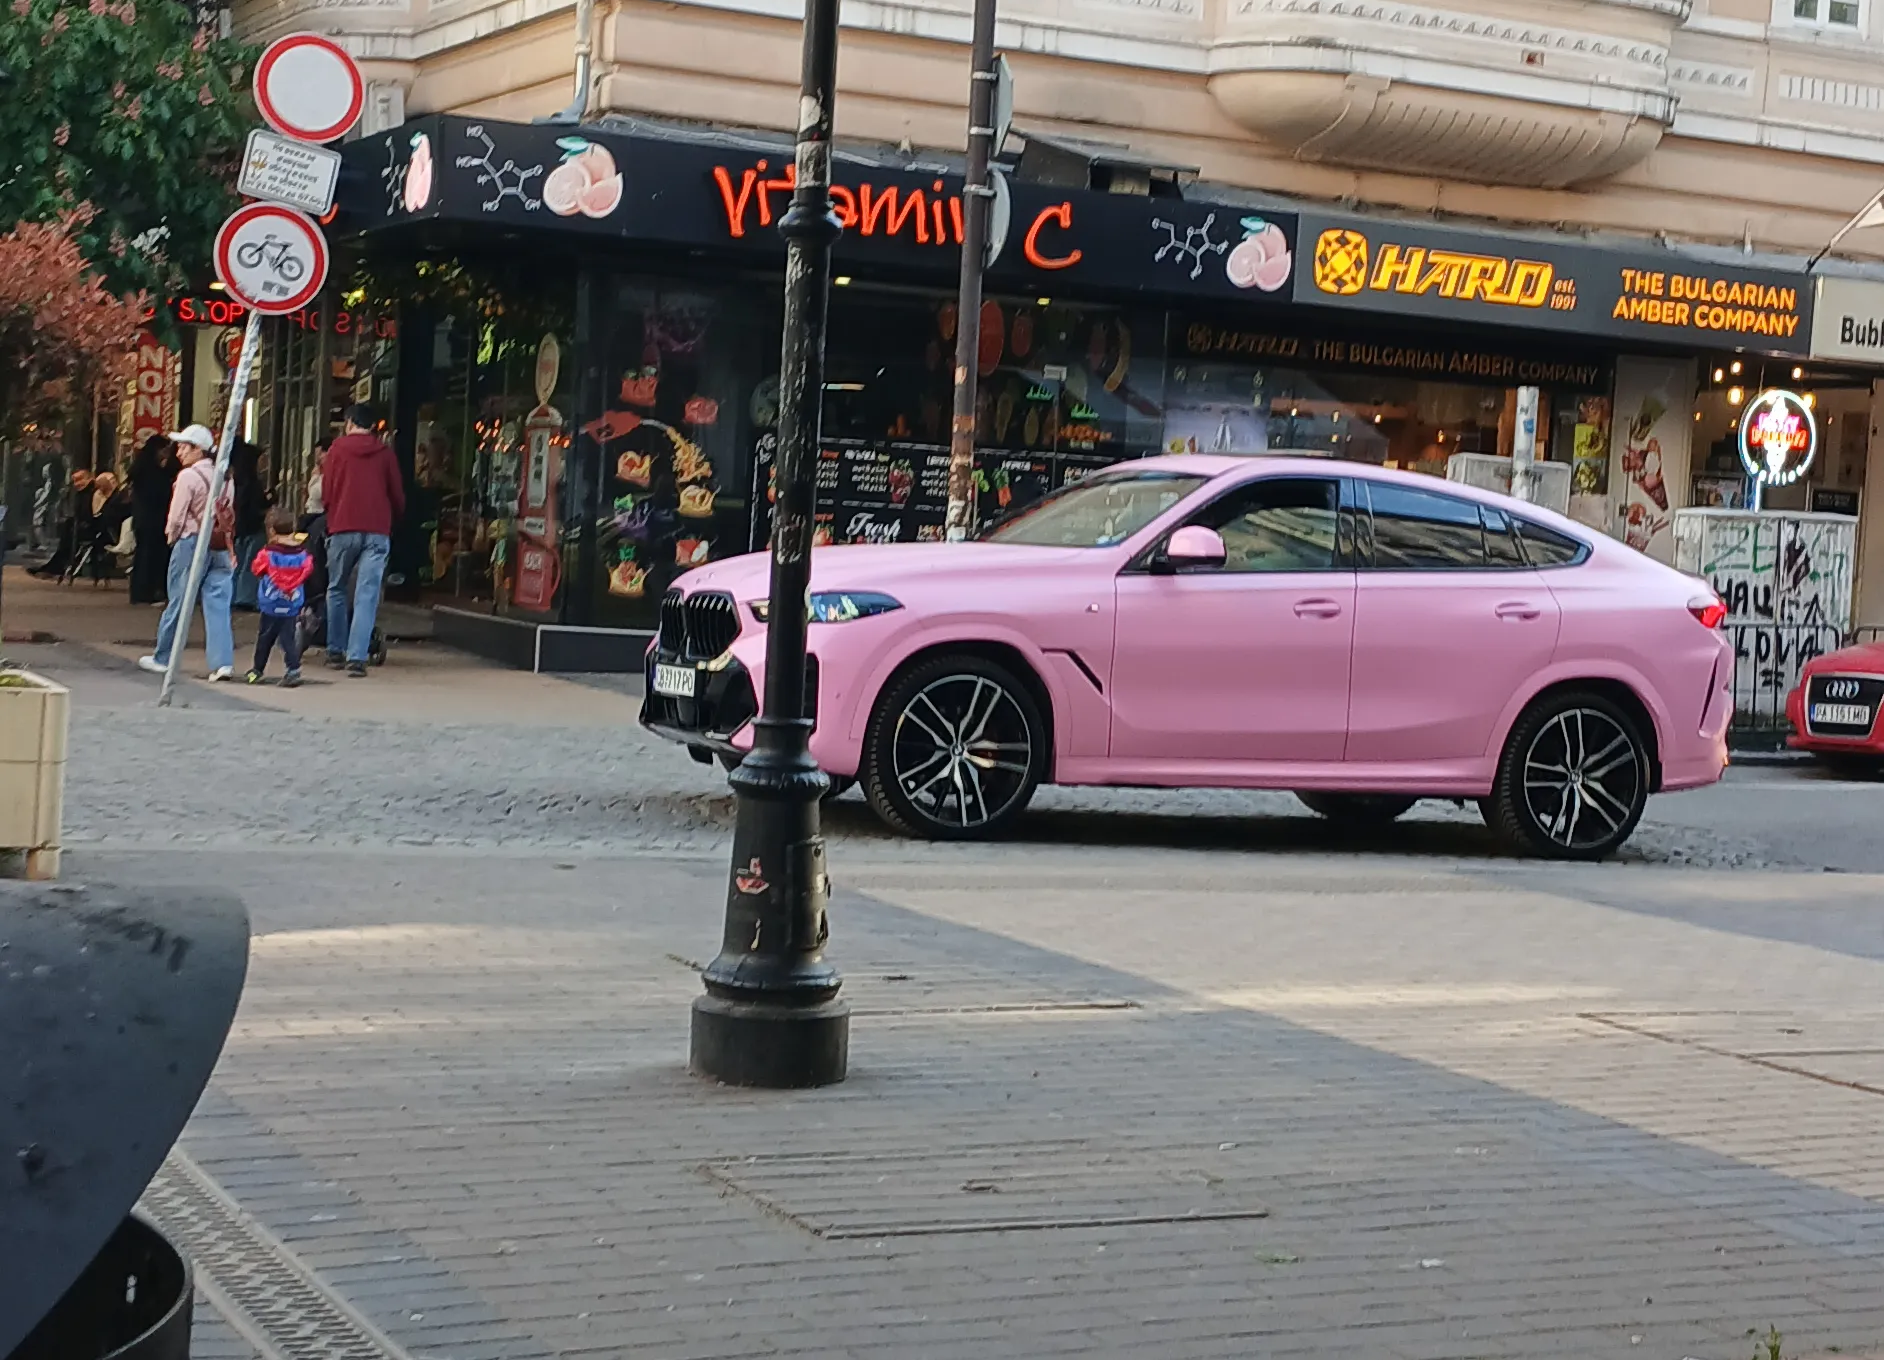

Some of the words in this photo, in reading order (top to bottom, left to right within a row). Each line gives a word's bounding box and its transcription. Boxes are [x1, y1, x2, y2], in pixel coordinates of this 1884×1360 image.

[1023, 201, 1083, 270] C
[1369, 243, 1554, 307] HARD
[1621, 268, 1666, 296] THE
[1670, 274, 1797, 311] BULGARIAN
[1612, 295, 1690, 326] AMBER
[1694, 304, 1799, 337] COMPANY
[137, 345, 165, 418] NON
[1314, 340, 1346, 361] THE
[1350, 342, 1445, 372] BULGARIAN
[1448, 350, 1514, 377] AMBER
[1518, 359, 1599, 386] COMPANY
